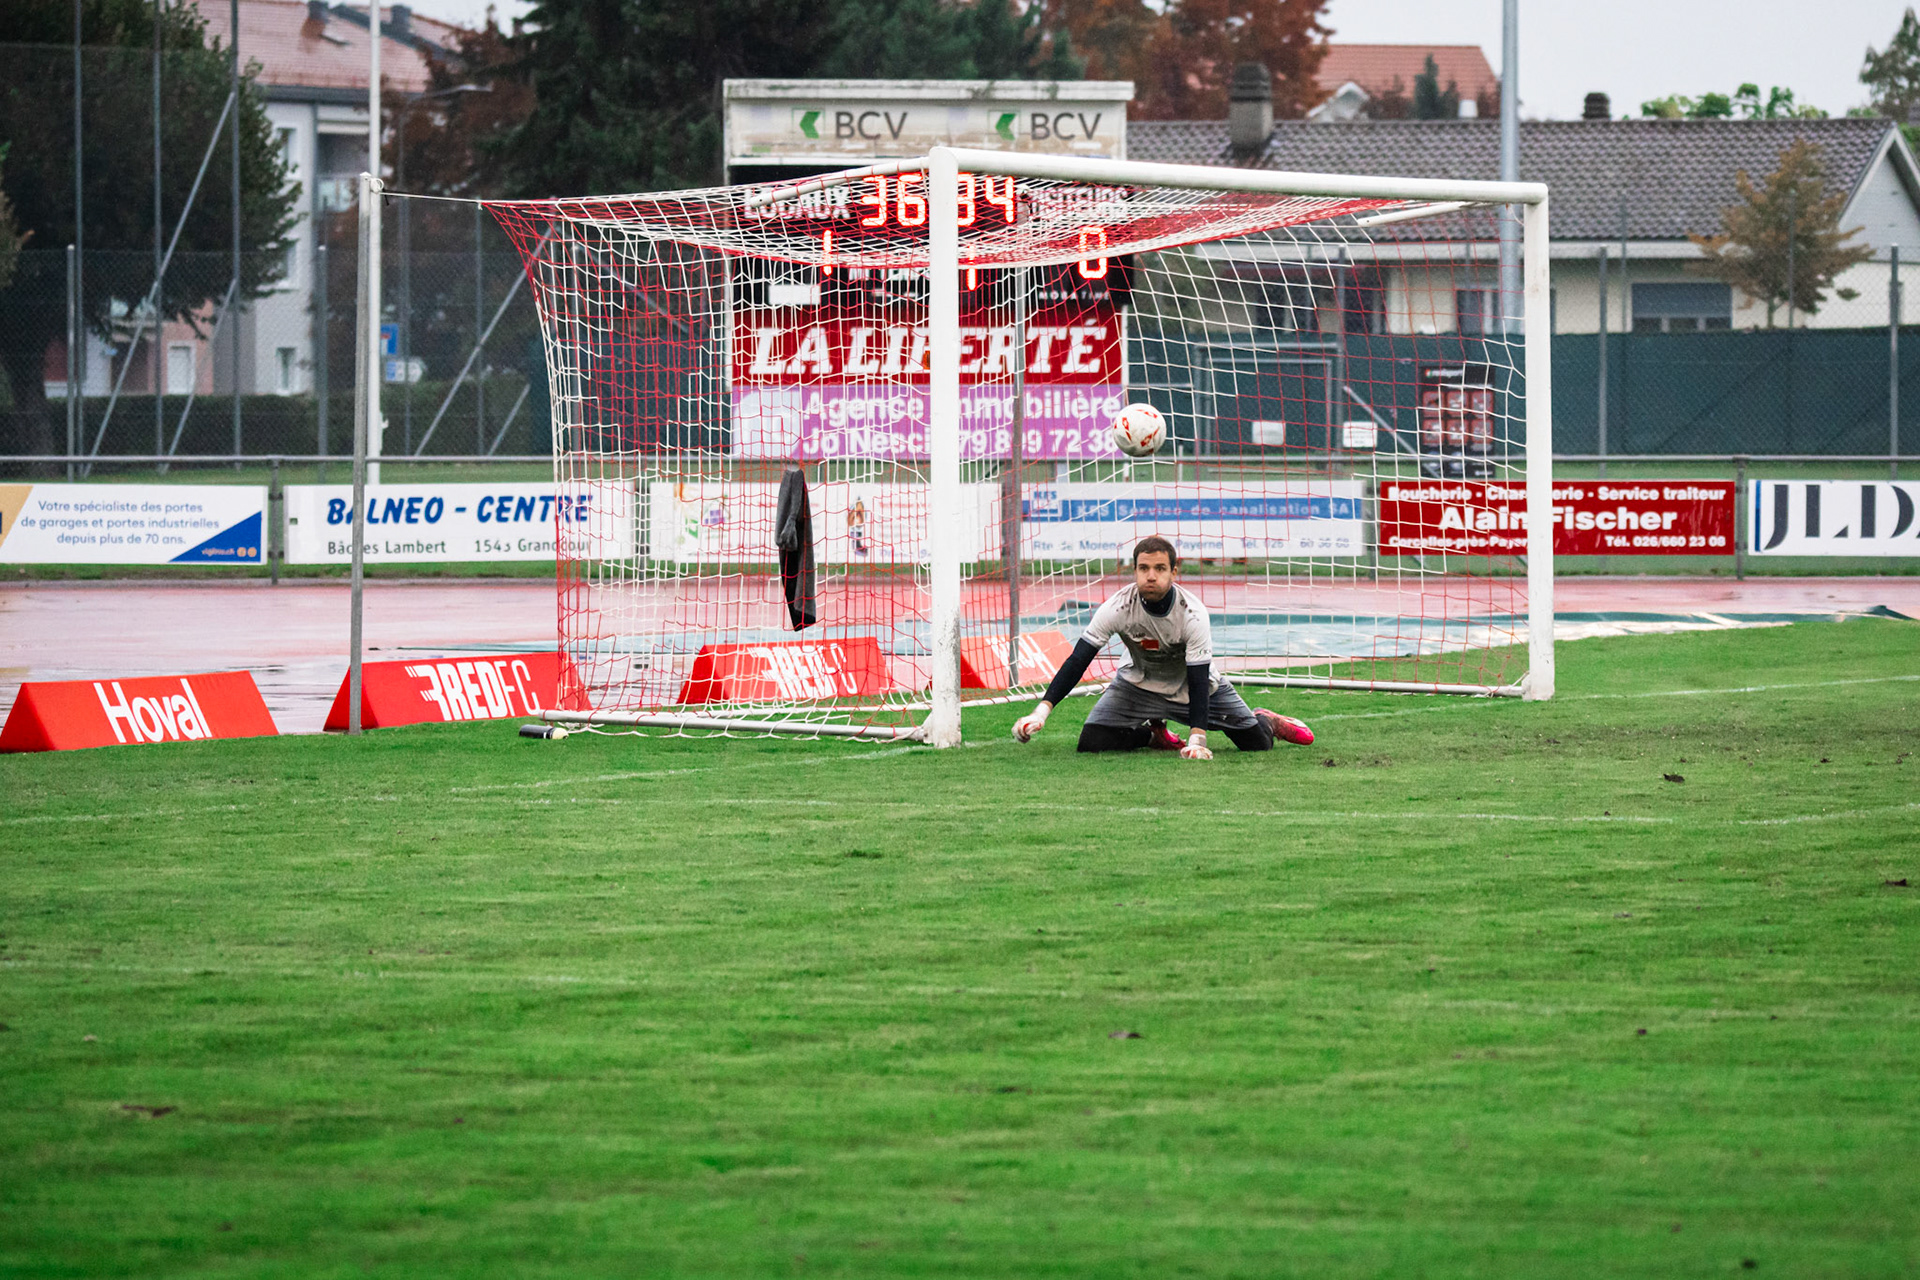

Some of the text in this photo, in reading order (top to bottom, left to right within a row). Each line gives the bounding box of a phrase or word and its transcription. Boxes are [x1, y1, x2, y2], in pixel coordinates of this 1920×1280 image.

[835, 111, 908, 140] BCV
[1030, 112, 1102, 140] BCV
[748, 326, 834, 375] LA
[801, 391, 925, 427] Agence
[803, 427, 840, 454] Jo
[1048, 428, 1082, 454] 72
[1387, 486, 1472, 500] Boucherie
[1597, 486, 1660, 501] Service
[1663, 487, 1727, 501] traiteur
[37, 500, 203, 514] Votre spécialiste des portes
[476, 494, 594, 523] CENTRE
[1190, 504, 1211, 516] de
[1438, 505, 1529, 530] Alain
[1764, 484, 1920, 551] JLD
[21, 515, 219, 531] de garages et portes industrielles
[56, 532, 187, 546] depuis plus de 70 ans.
[385, 540, 446, 554] Lambert
[1174, 539, 1224, 552] Payerne
[1605, 535, 1631, 548] Tél.
[1689, 536, 1706, 548] 23
[93, 678, 213, 744] Hoval
